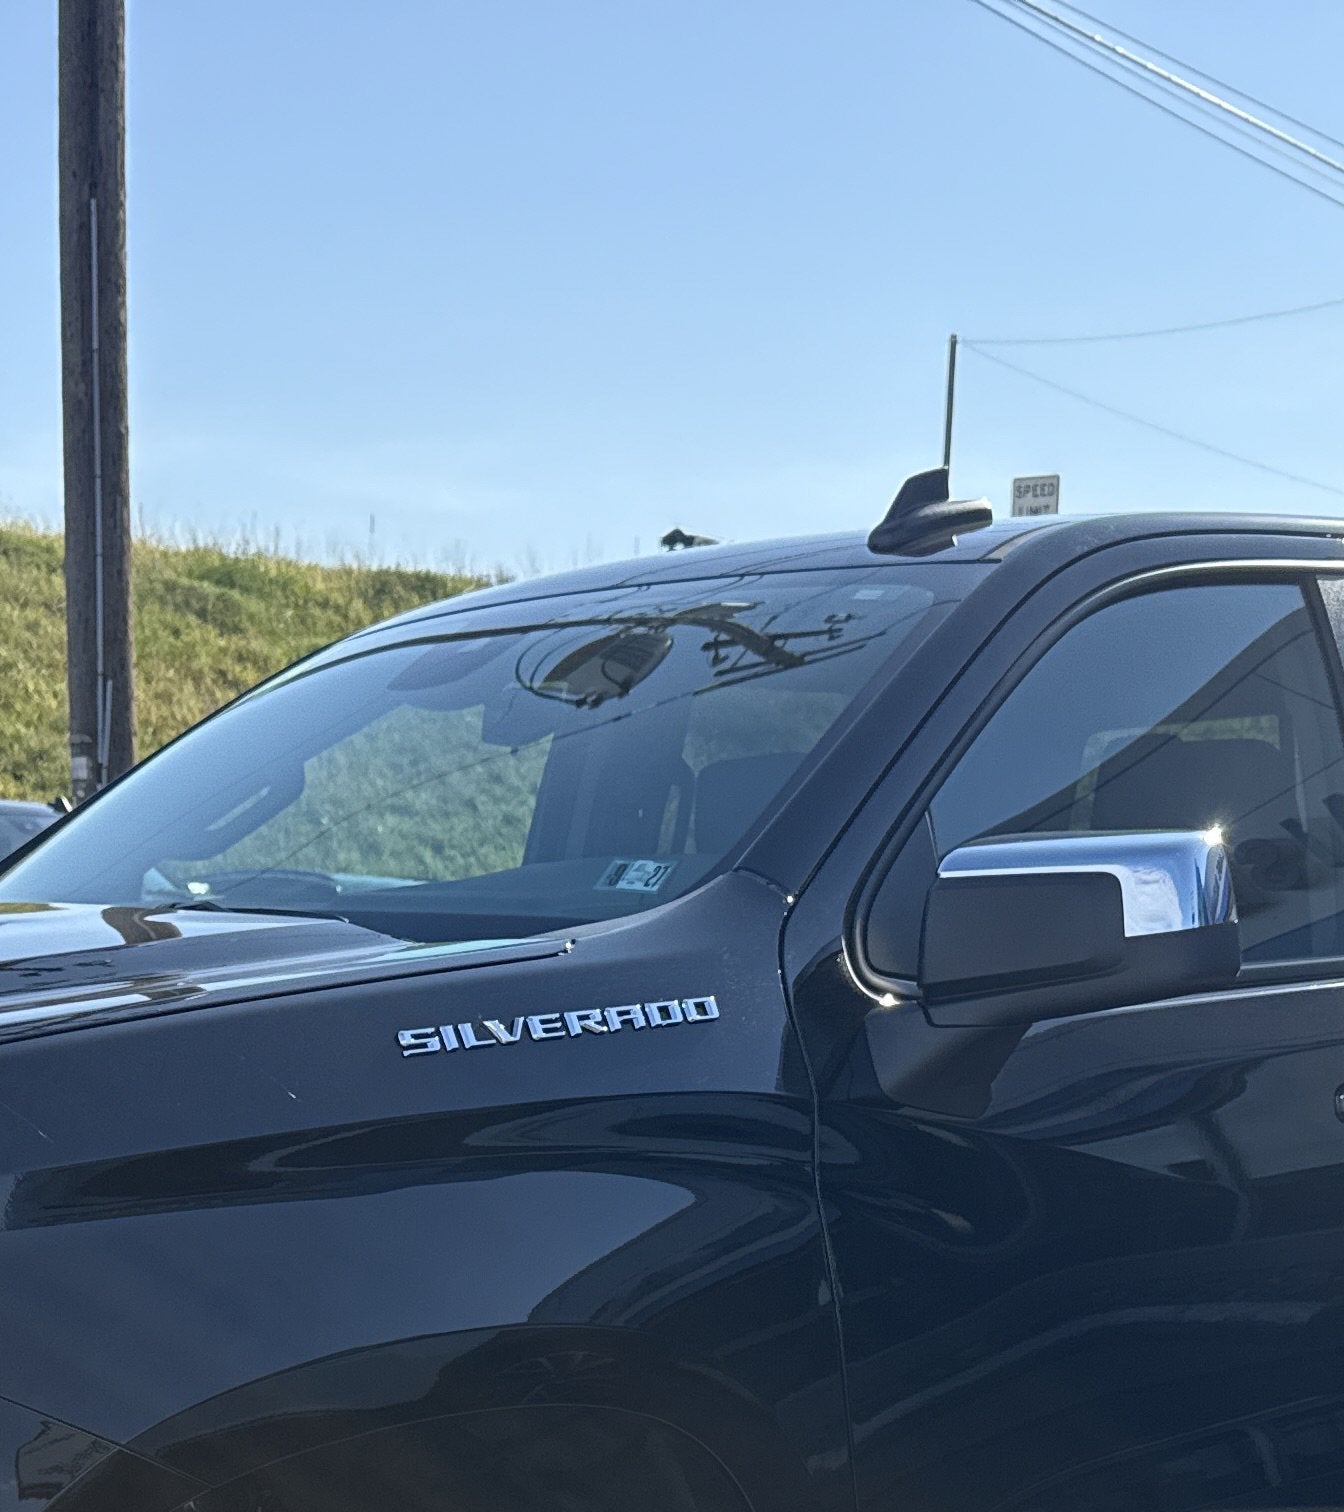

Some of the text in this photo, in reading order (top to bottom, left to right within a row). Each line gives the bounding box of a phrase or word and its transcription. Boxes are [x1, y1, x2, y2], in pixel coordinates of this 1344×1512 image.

[1015, 483, 1055, 499] SPEED
[643, 865, 670, 888] 27
[397, 995, 720, 1058] SILVERADO
